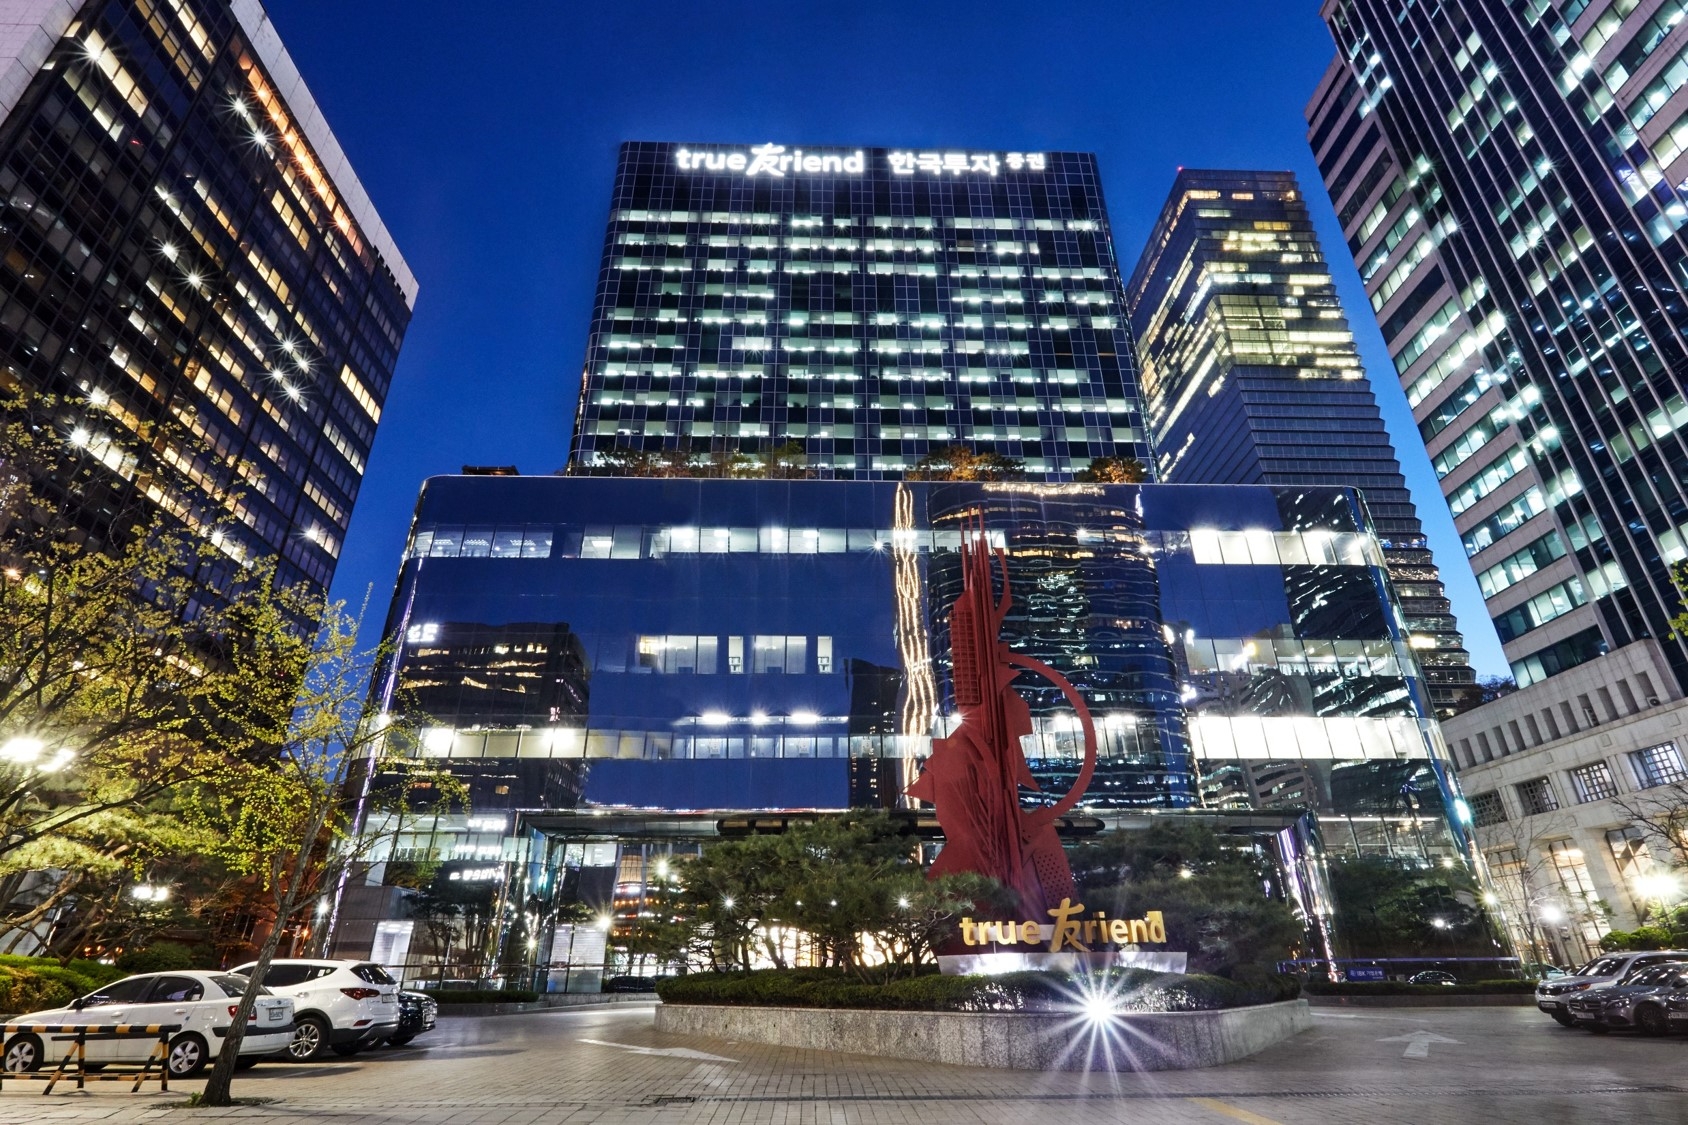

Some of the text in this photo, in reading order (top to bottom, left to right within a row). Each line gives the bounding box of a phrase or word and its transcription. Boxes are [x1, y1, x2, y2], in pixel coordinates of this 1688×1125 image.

[887, 152, 1045, 176] 한국투자 증권
[960, 917, 1041, 945] true
